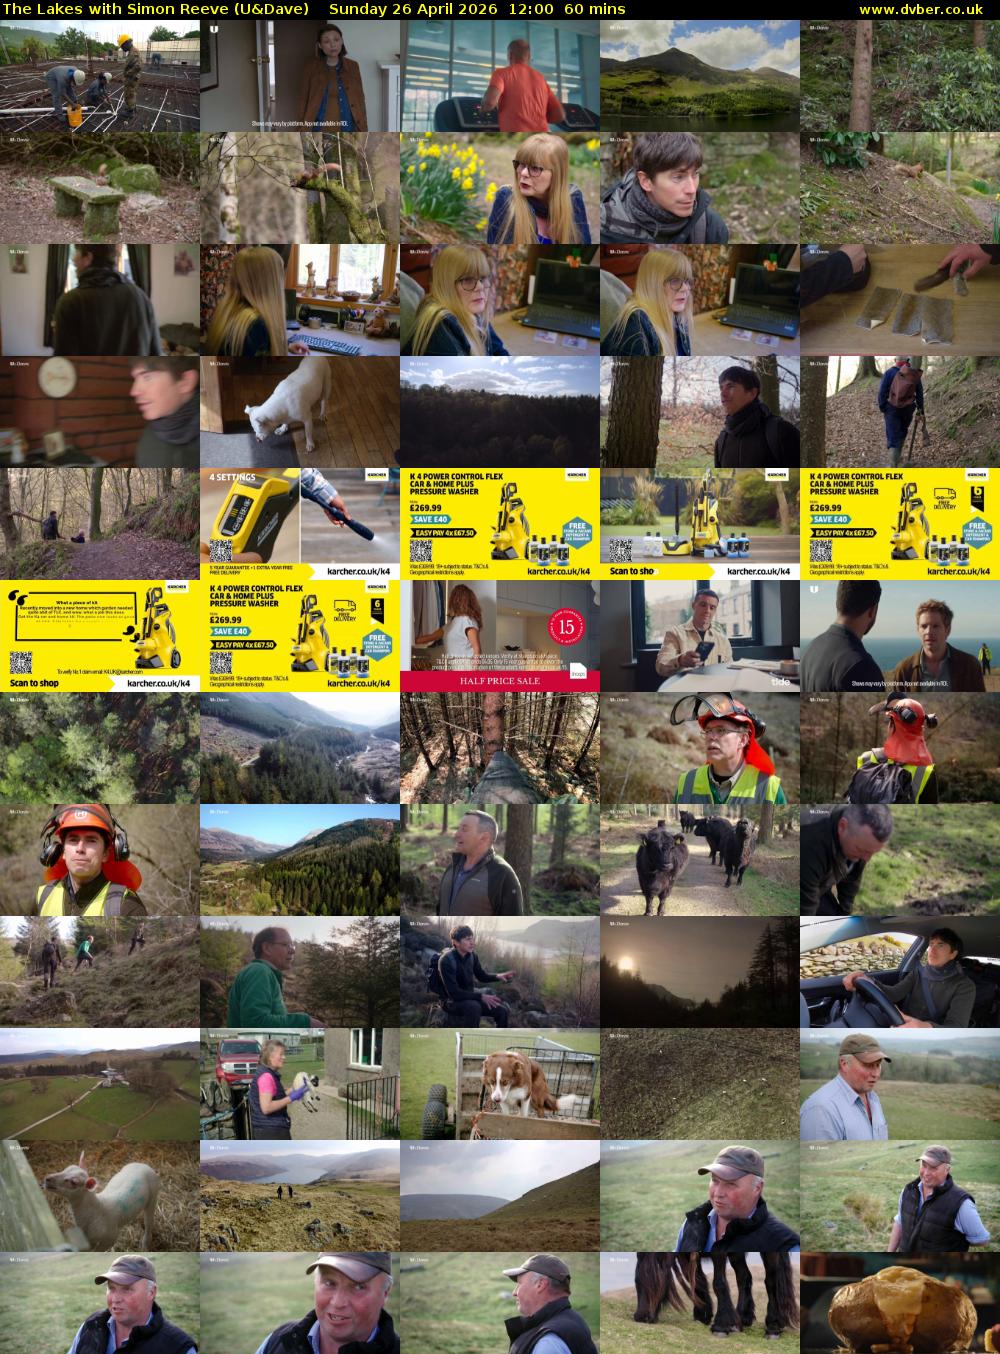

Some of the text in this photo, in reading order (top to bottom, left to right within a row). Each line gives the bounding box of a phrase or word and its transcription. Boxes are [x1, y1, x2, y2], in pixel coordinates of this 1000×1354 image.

[560, 620, 574, 634] 15
[10, 680, 59, 688] Scan to shop
